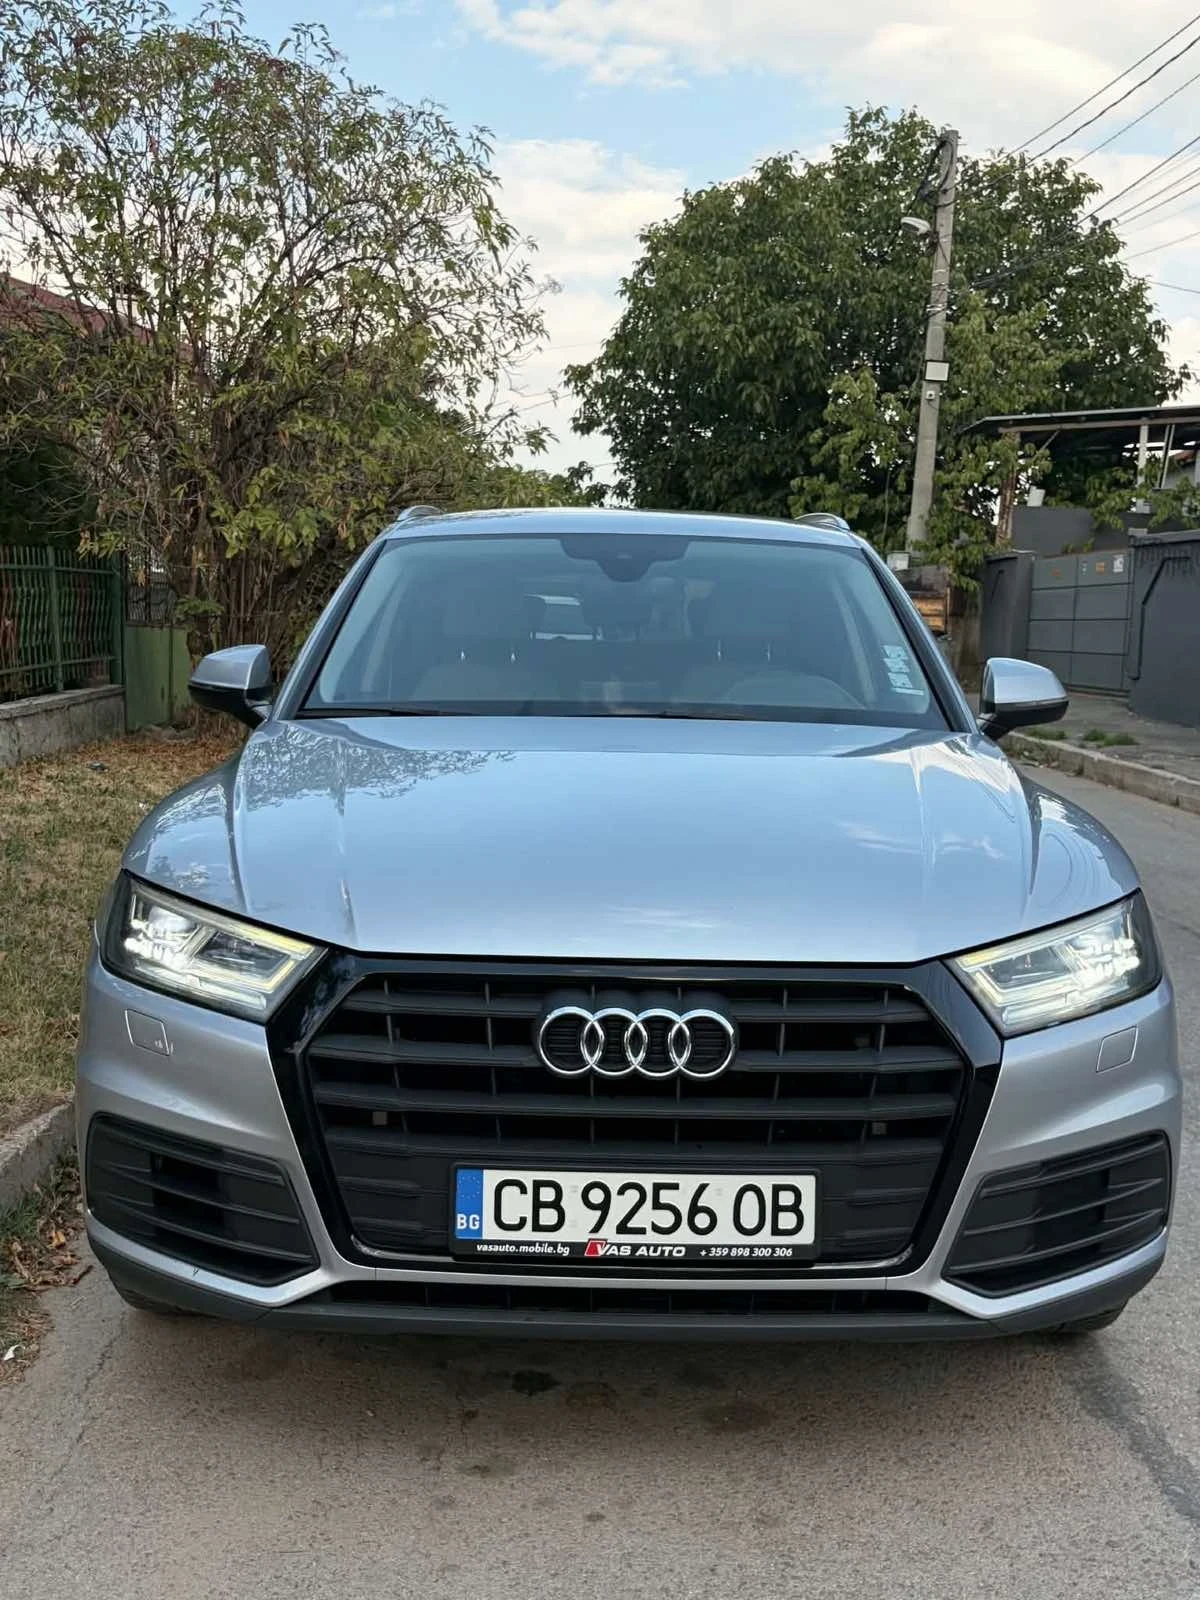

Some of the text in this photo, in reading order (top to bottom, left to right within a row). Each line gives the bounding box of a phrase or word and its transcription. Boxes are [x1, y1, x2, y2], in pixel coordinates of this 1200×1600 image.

[493, 1178, 566, 1233] CB
[580, 1180, 718, 1236] 9256
[456, 1214, 480, 1230] BG
[476, 1242, 570, 1257] vasauto.mobile.bg
[594, 1243, 686, 1257] VAS AUTO
[730, 1247, 751, 1257] 898
[752, 1247, 773, 1257] 300
[774, 1247, 793, 1257] 306
